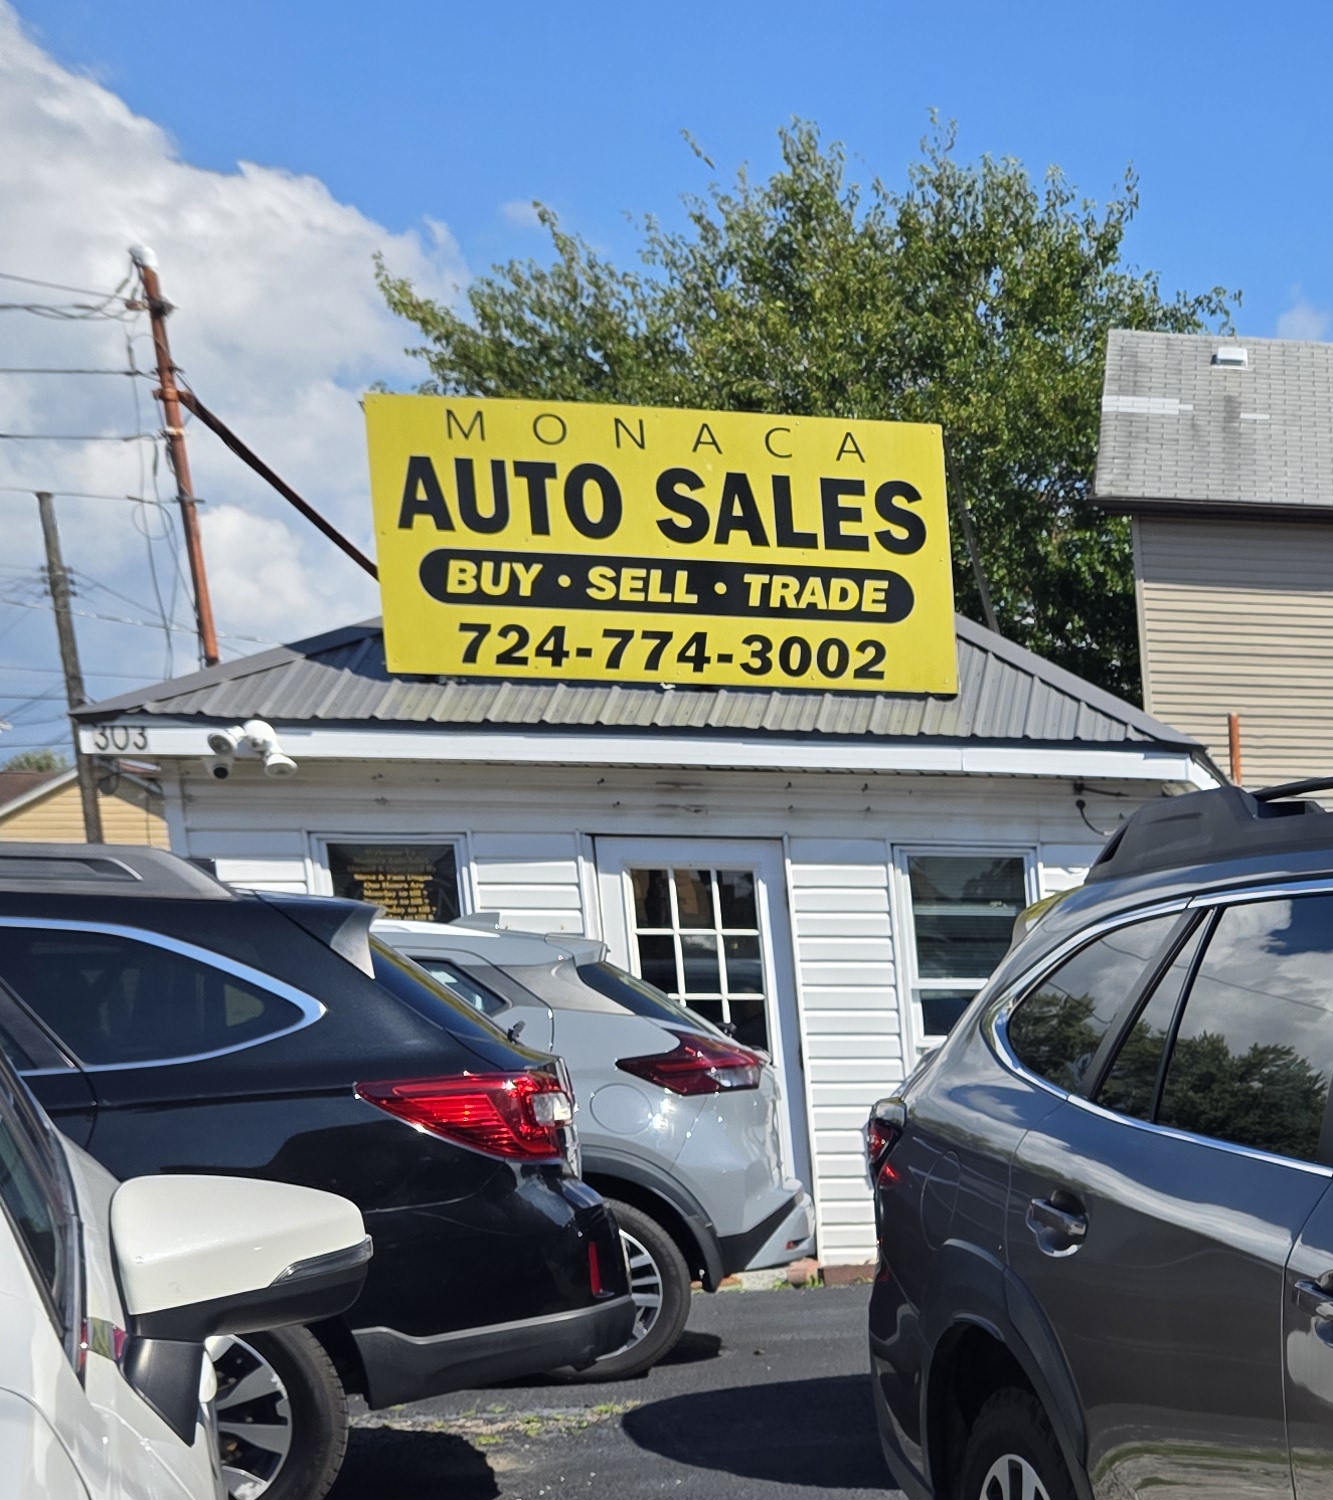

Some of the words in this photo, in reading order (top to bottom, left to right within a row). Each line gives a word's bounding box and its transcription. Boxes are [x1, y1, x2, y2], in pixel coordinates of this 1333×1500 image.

[446, 408, 866, 463] MONACA
[398, 455, 623, 540] AUTO
[655, 467, 927, 556] SALES
[446, 559, 543, 597] BUY
[586, 565, 699, 604] SELL
[743, 573, 890, 613] TRADE
[458, 622, 886, 680] 724-774-3002
[95, 725, 148, 751] 303
